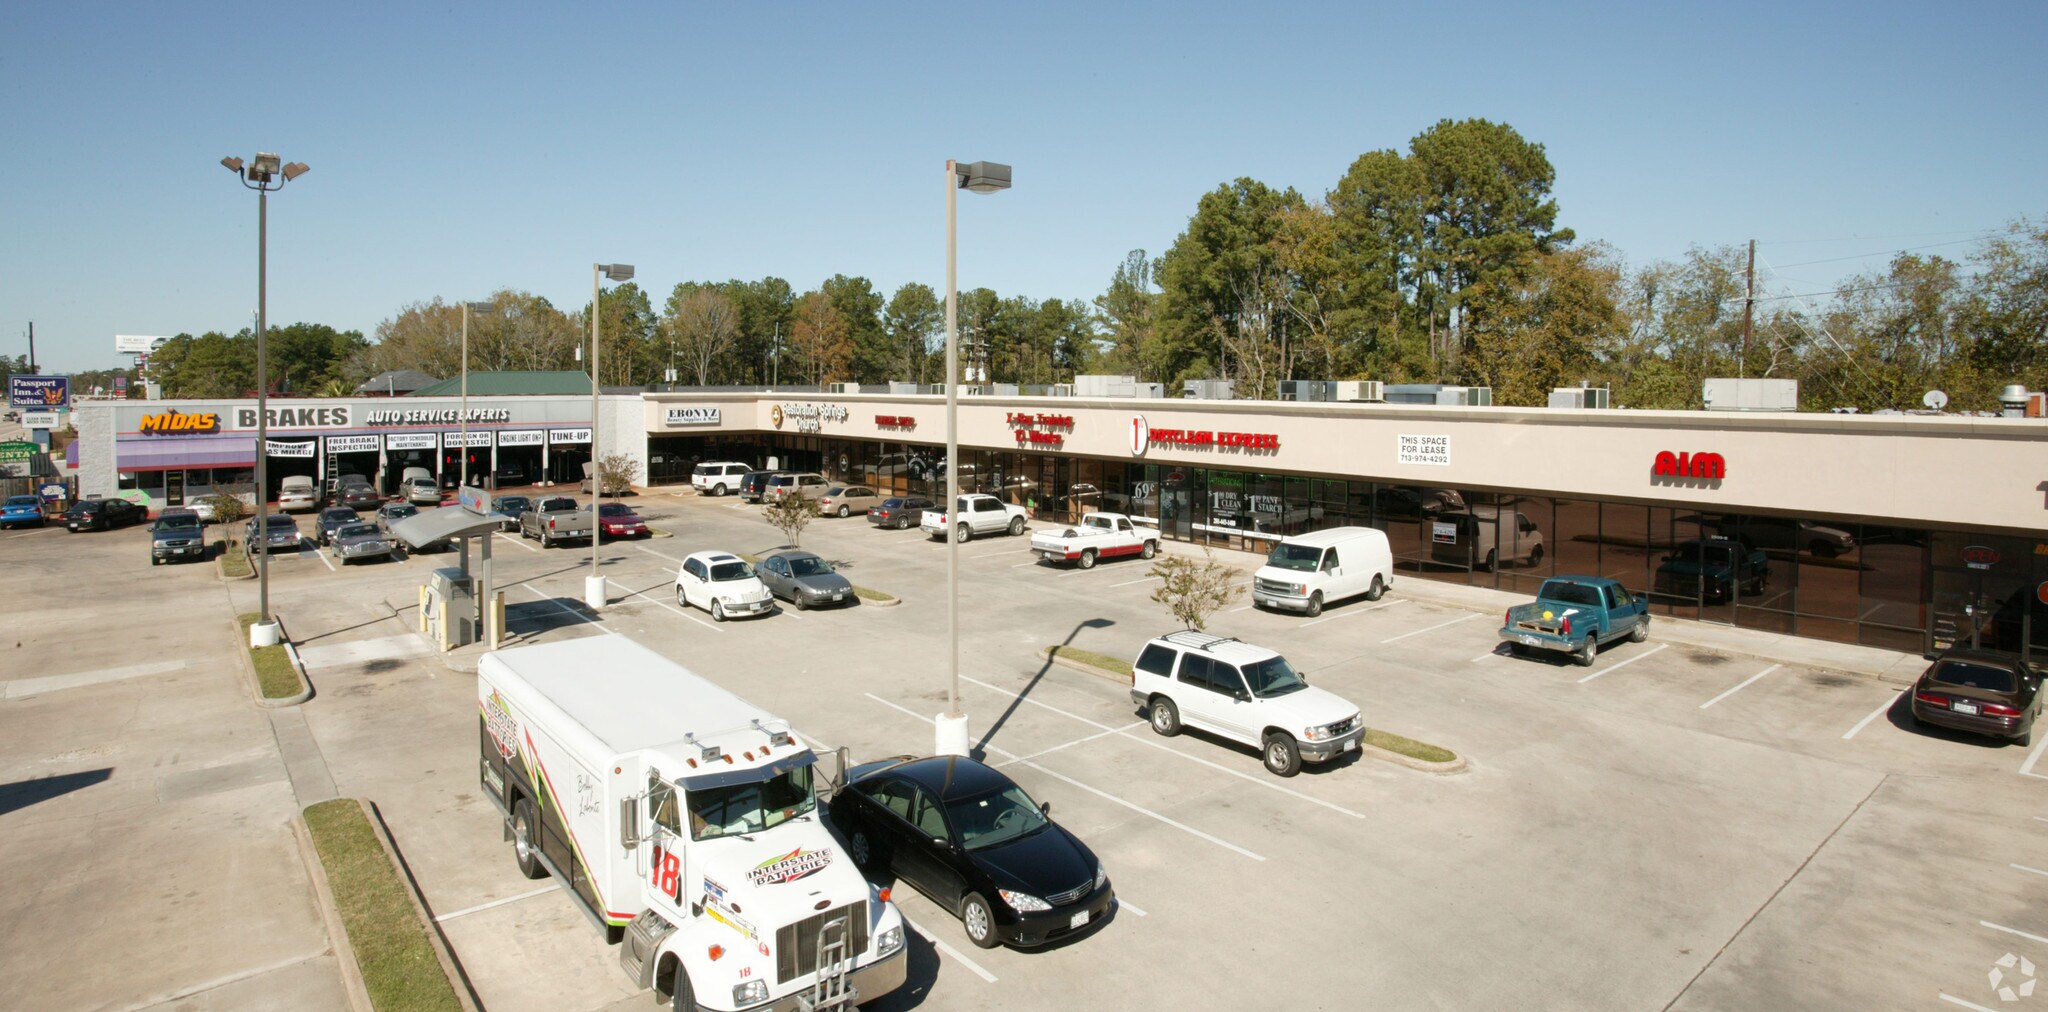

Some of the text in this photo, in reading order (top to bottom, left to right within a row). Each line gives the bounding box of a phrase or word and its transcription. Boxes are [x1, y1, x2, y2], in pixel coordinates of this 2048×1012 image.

[13, 379, 56, 388] Passport
[238, 407, 348, 428] BRAKES
[366, 408, 508, 423] AUTO SERVICE EXPERTS
[669, 409, 718, 417] EBONYZ
[139, 413, 217, 432] MIDAS
[797, 418, 819, 430] Church
[500, 433, 542, 443] ENGINE LIGHT ON?
[551, 432, 589, 441] TUNE-UP
[1149, 428, 1278, 449] DRYCLEAN EXPRESS
[1401, 436, 1447, 445] THIS SPACE
[1401, 445, 1446, 454] FOR LEASE
[1655, 450, 1725, 479] AIM
[1225, 492, 1237, 500] DRY
[1221, 500, 1241, 508] CLEAN
[1258, 503, 1283, 513] STARCH
[747, 848, 831, 879] INTERSTATE
[652, 844, 680, 899] 18
[756, 857, 832, 886] BATTERIES
[739, 966, 752, 978] 18
